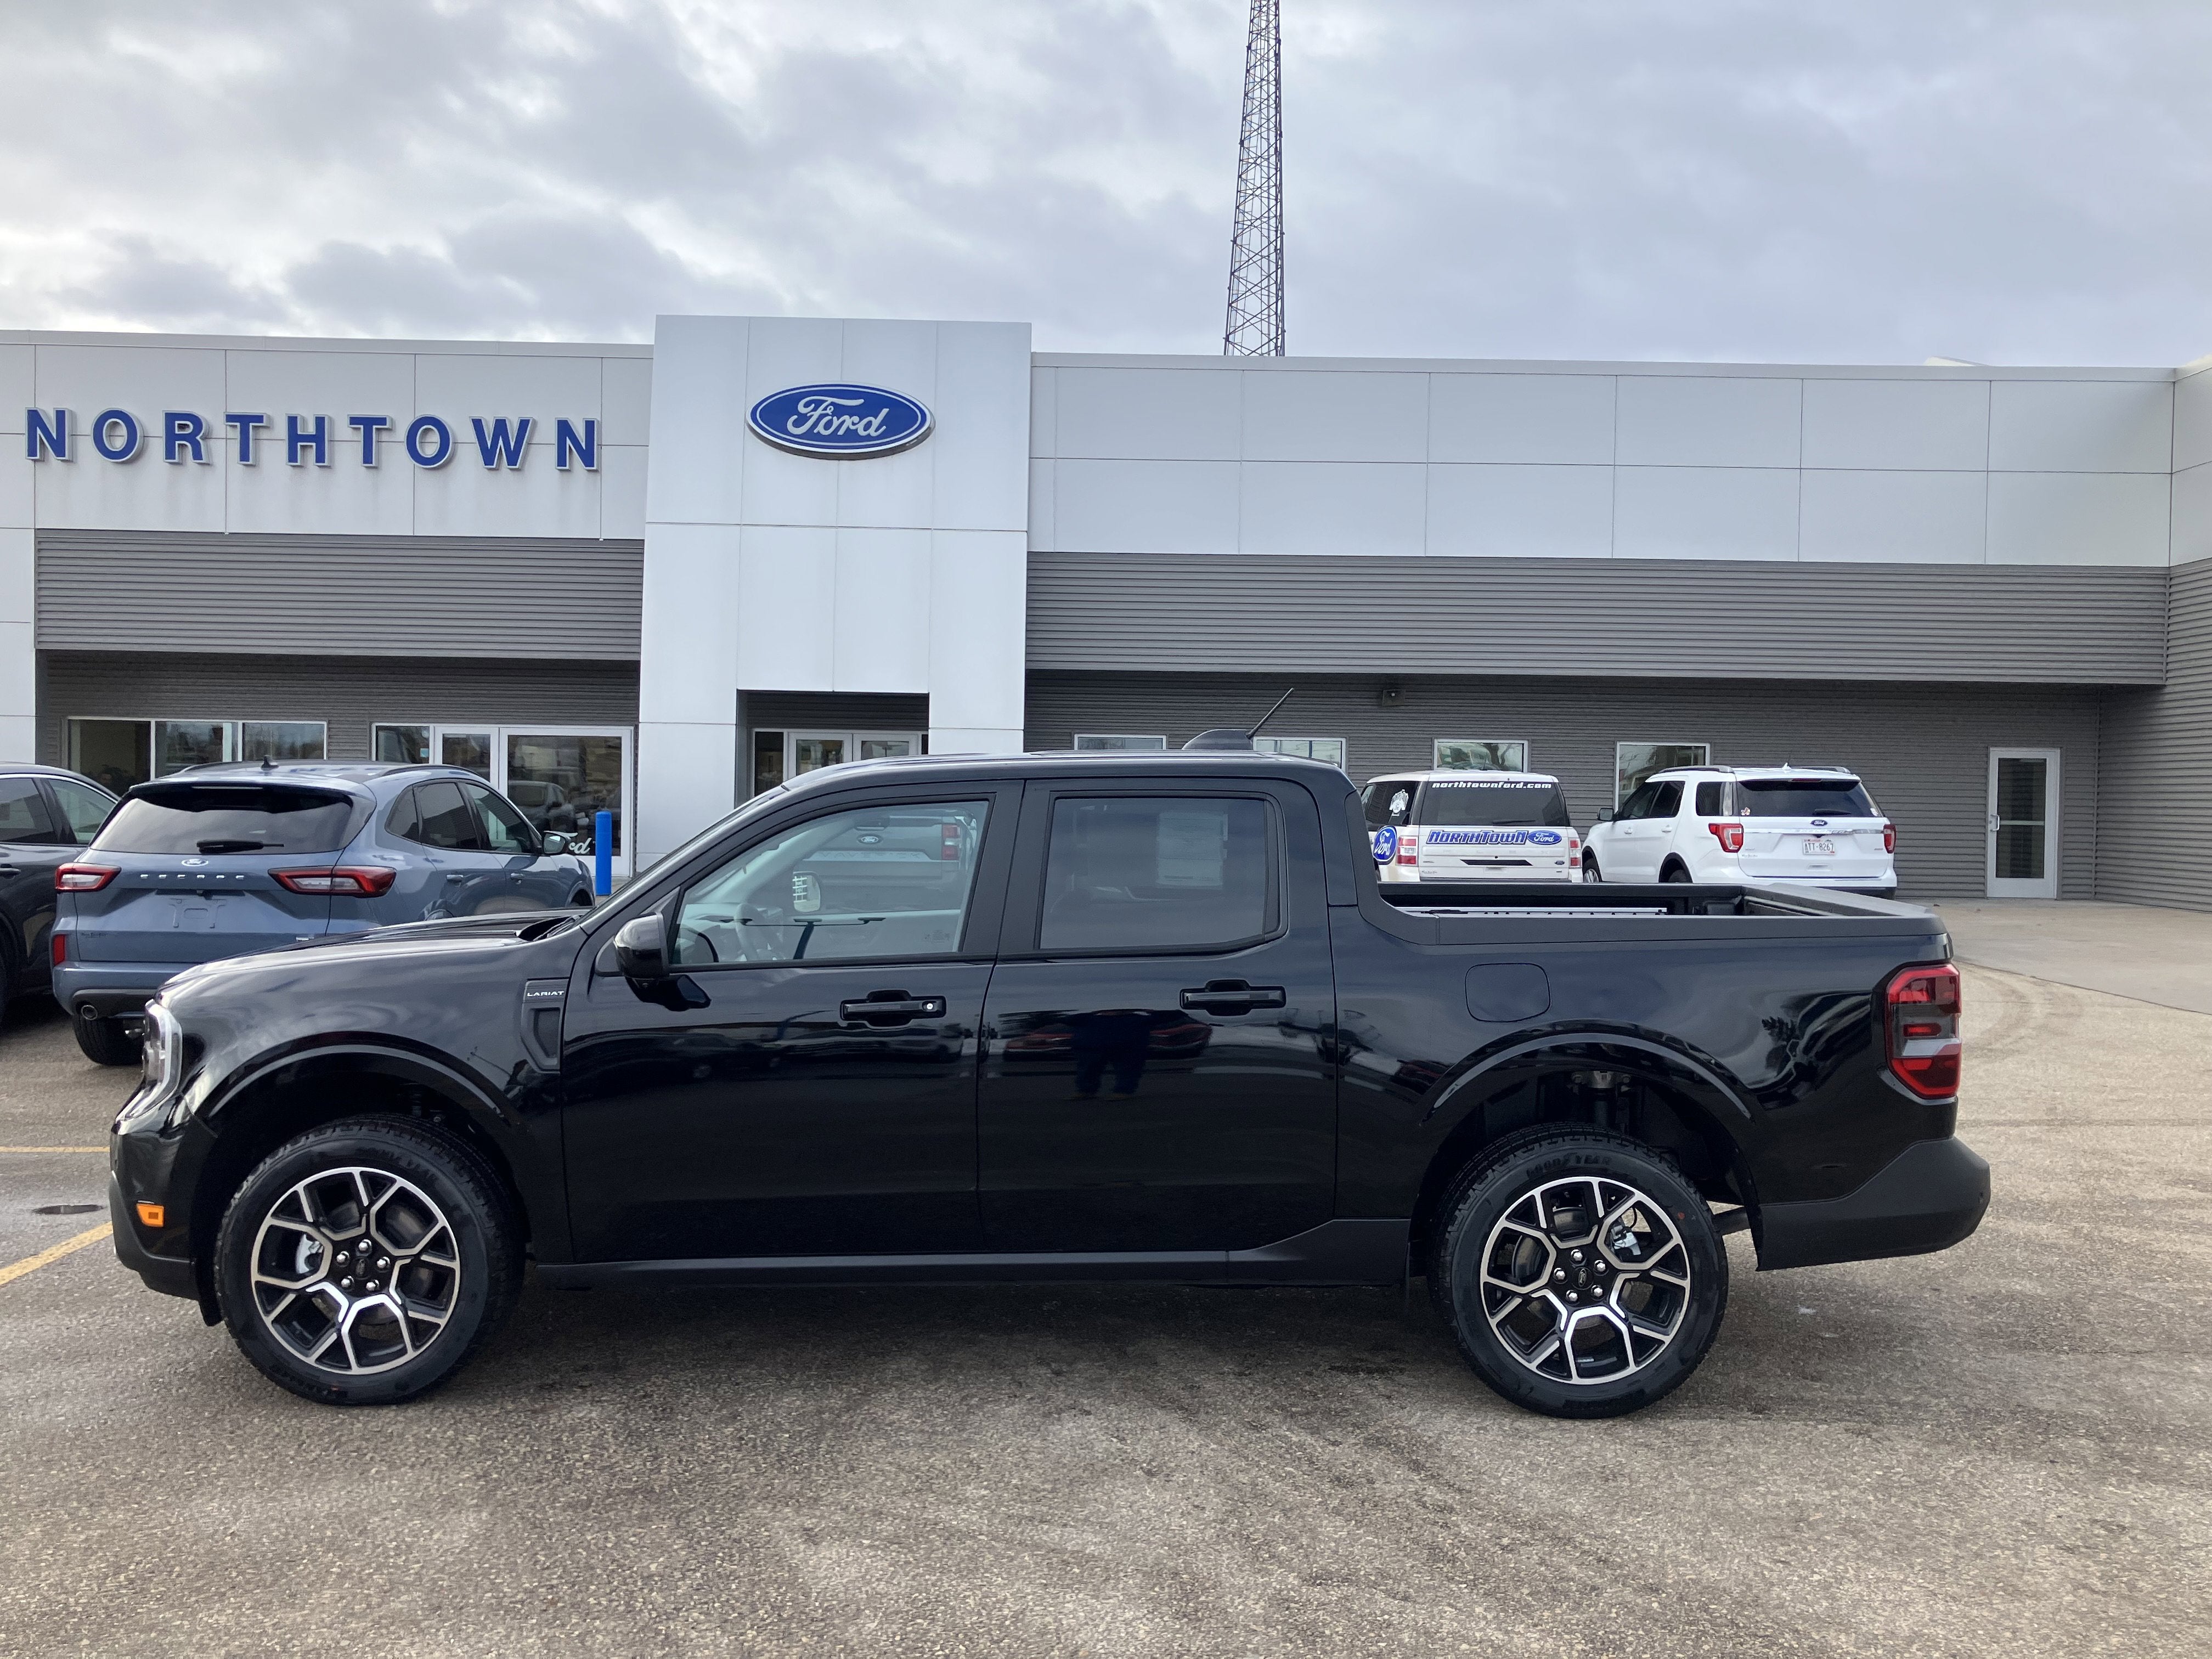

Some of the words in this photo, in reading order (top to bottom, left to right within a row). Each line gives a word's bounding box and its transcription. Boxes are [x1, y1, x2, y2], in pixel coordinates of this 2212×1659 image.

[787, 396, 889, 437] Ford
[25, 407, 599, 472] NORTHTOWN
[1432, 781, 1551, 789] northtownford.com
[1374, 831, 1392, 856] Ford
[1427, 830, 1528, 844] NORTHTOWN
